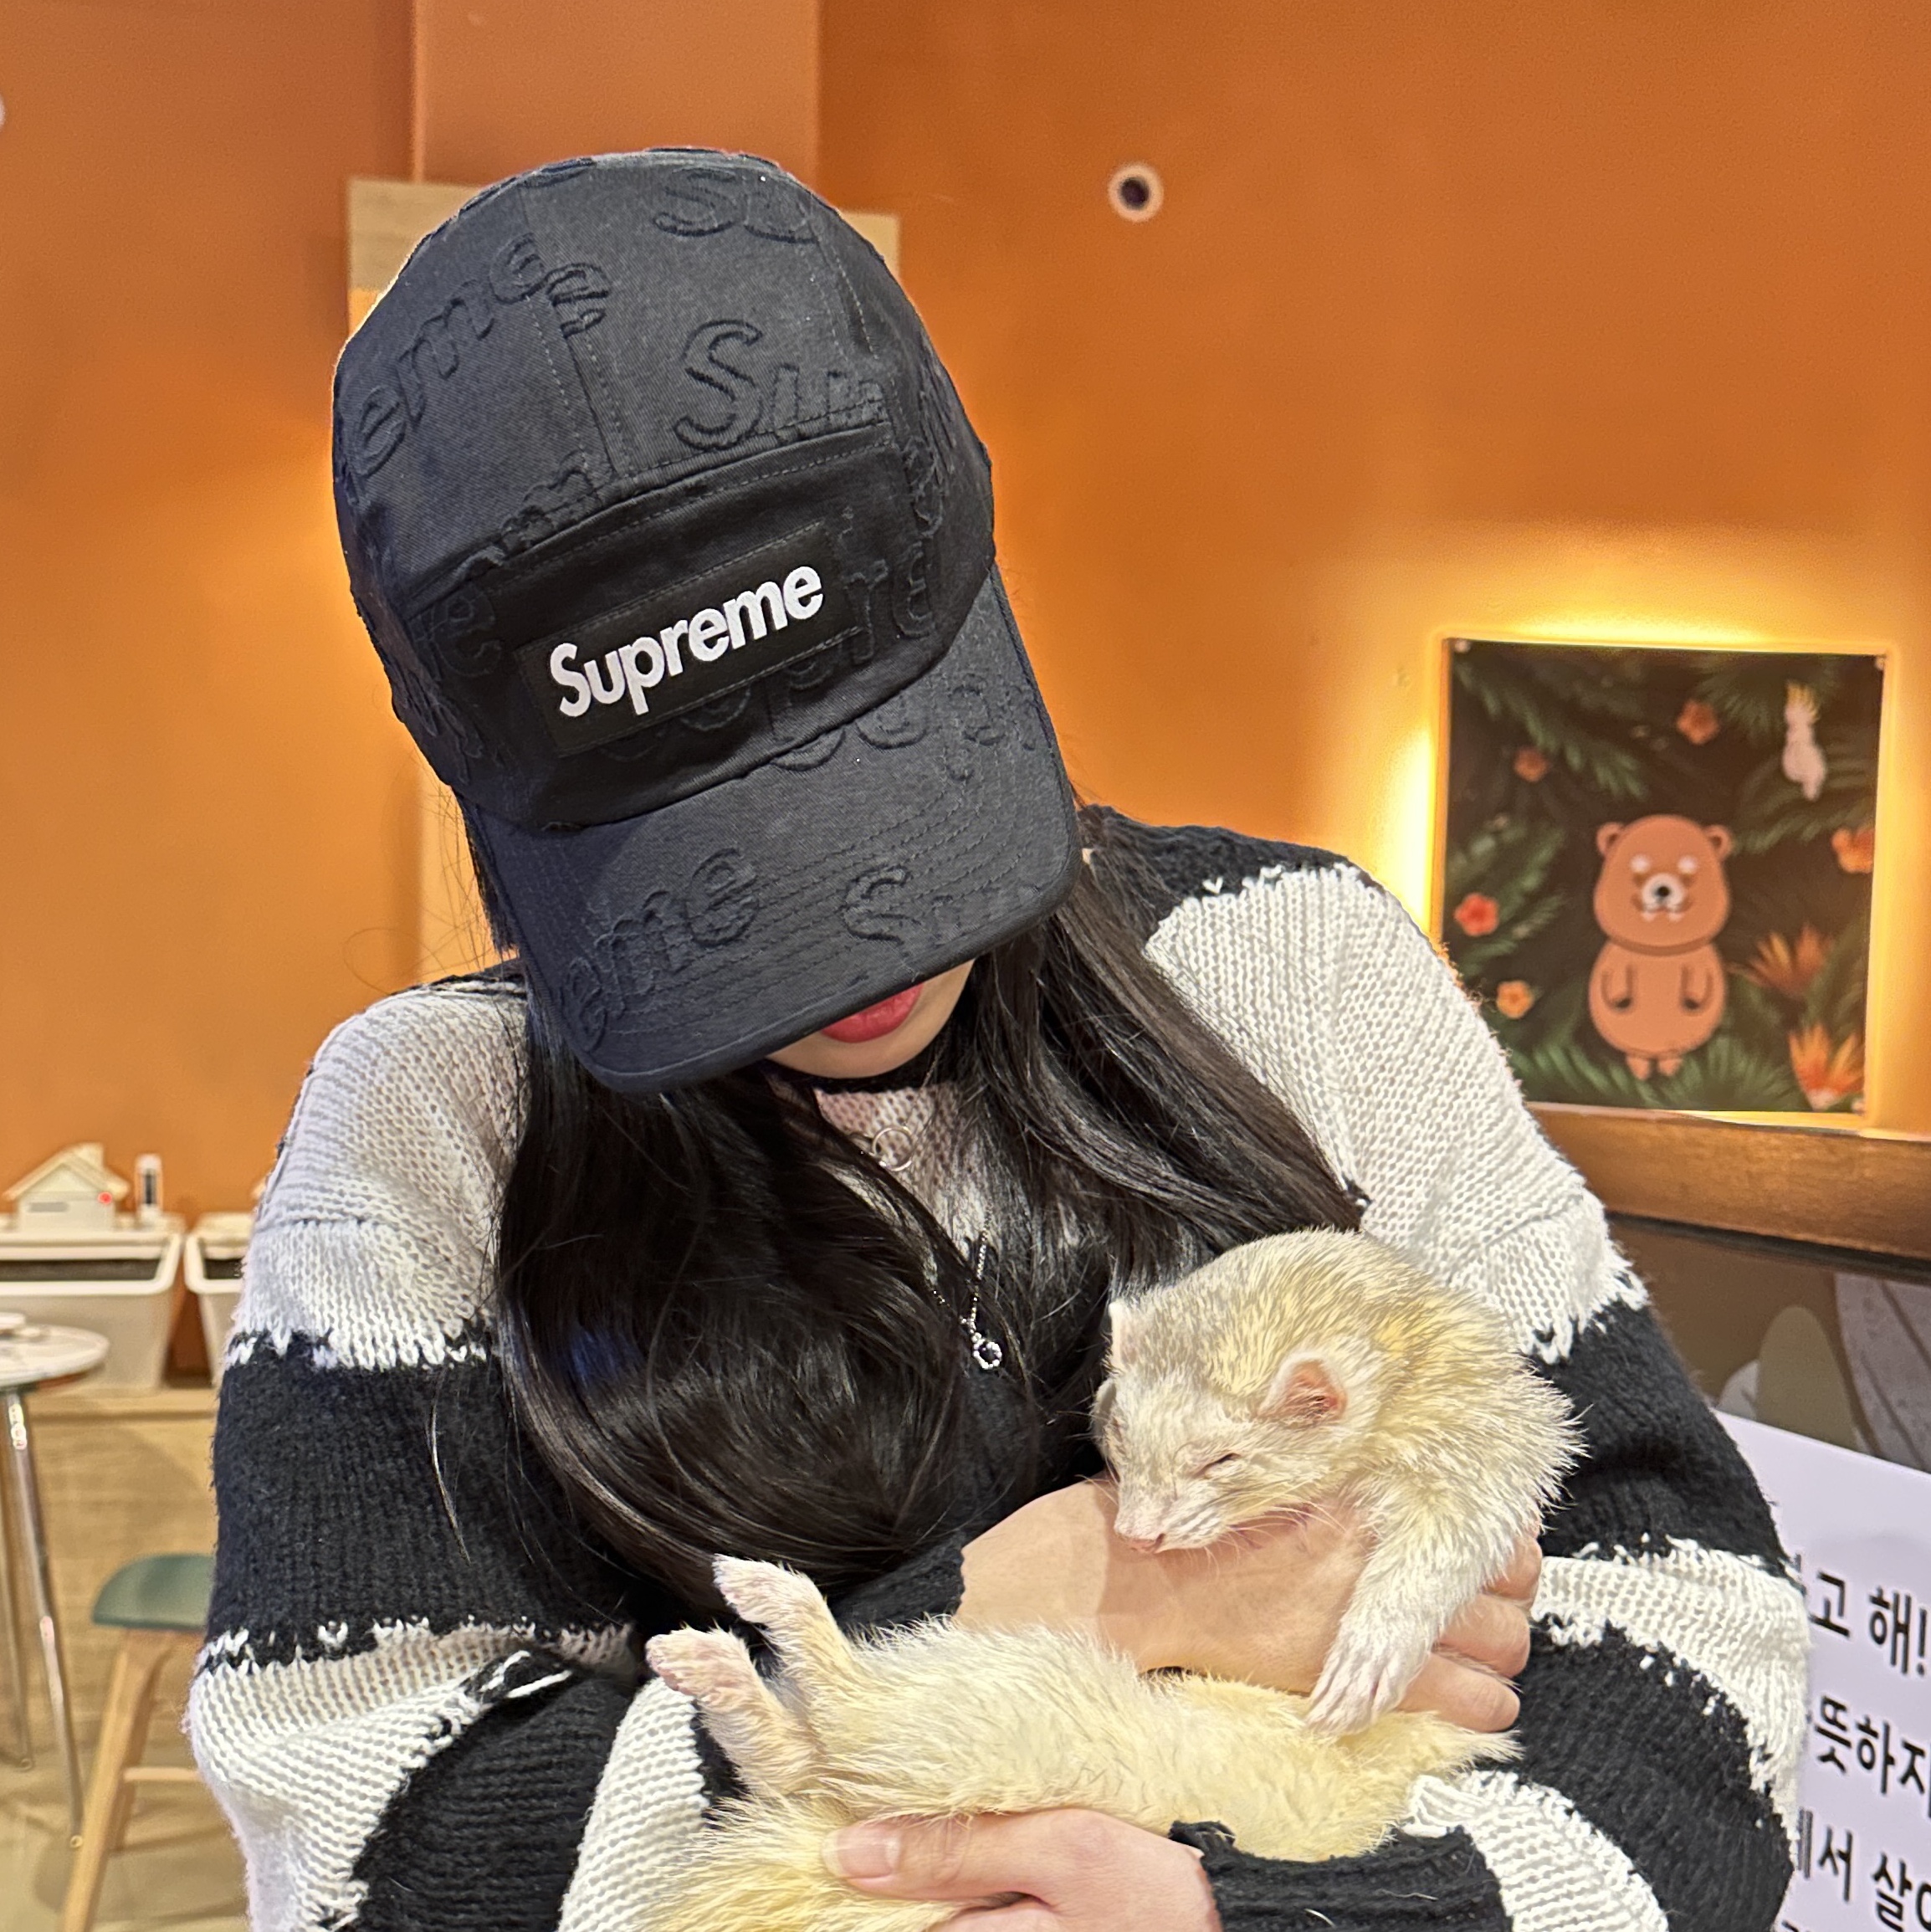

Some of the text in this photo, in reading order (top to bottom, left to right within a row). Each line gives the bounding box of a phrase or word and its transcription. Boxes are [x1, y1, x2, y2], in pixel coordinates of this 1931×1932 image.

[549, 566, 824, 717] Supreme
[1868, 1586, 1928, 1677] 해!
[1806, 1695, 1931, 1818] 뜻하지
[1872, 1852, 1931, 1932] 살
